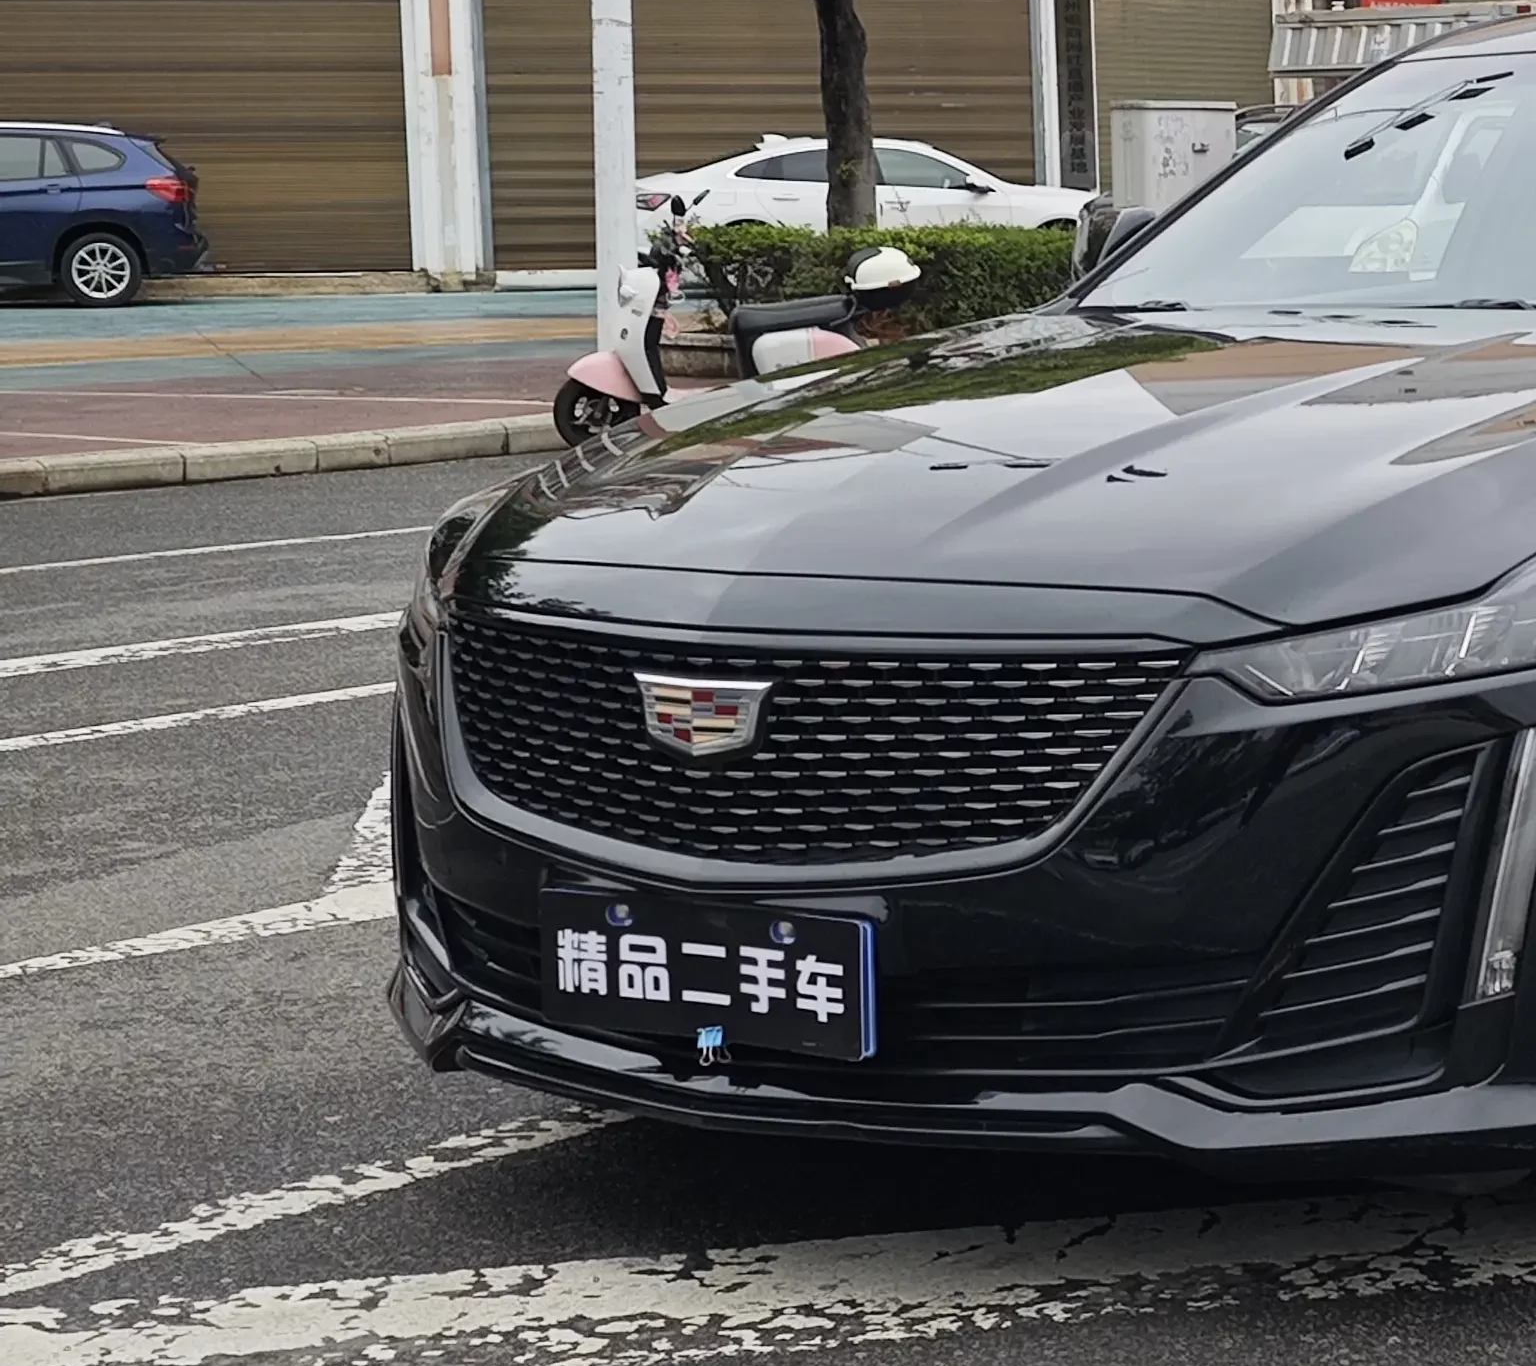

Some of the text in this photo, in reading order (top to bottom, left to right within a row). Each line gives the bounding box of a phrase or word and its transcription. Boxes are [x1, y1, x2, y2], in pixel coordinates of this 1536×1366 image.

[556, 928, 846, 1023] 精品二手车
